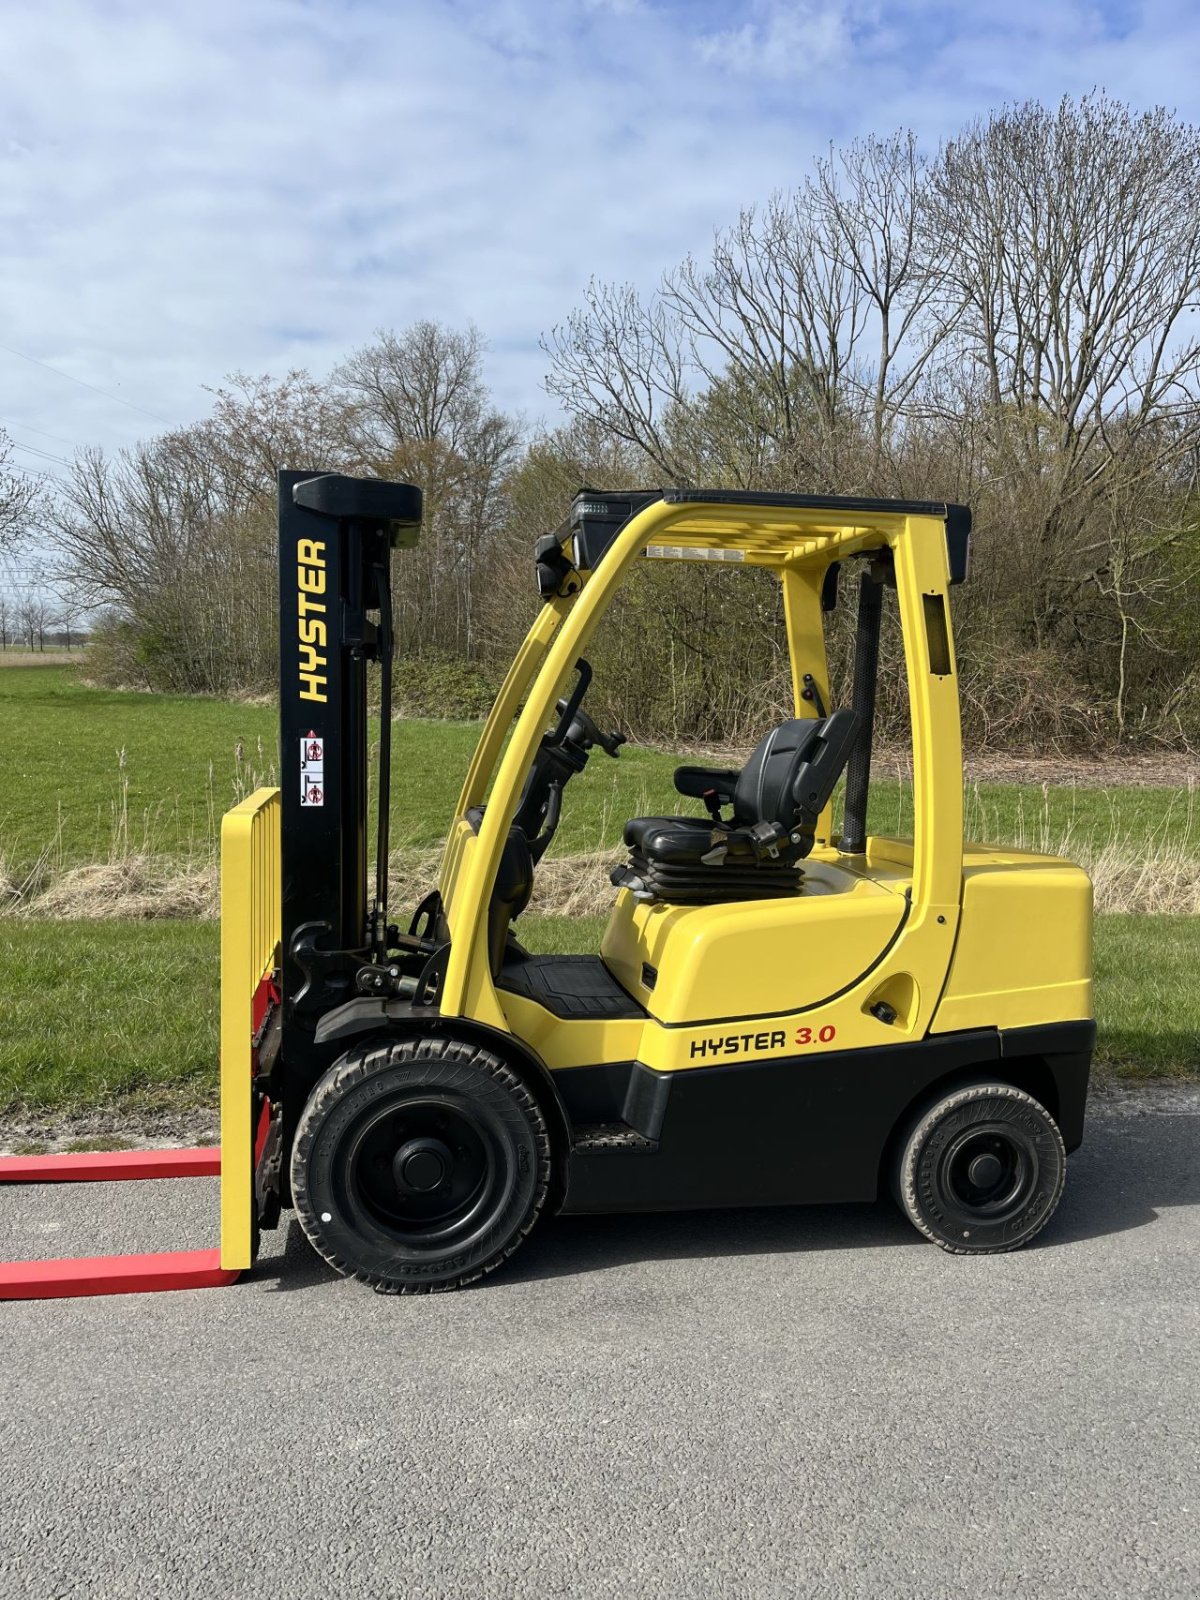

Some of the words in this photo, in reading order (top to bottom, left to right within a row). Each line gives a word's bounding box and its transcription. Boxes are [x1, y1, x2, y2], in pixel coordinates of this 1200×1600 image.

[297, 538, 328, 703] HYSTER
[690, 1030, 786, 1059] HYSTER
[794, 1024, 836, 1045] 3.0
